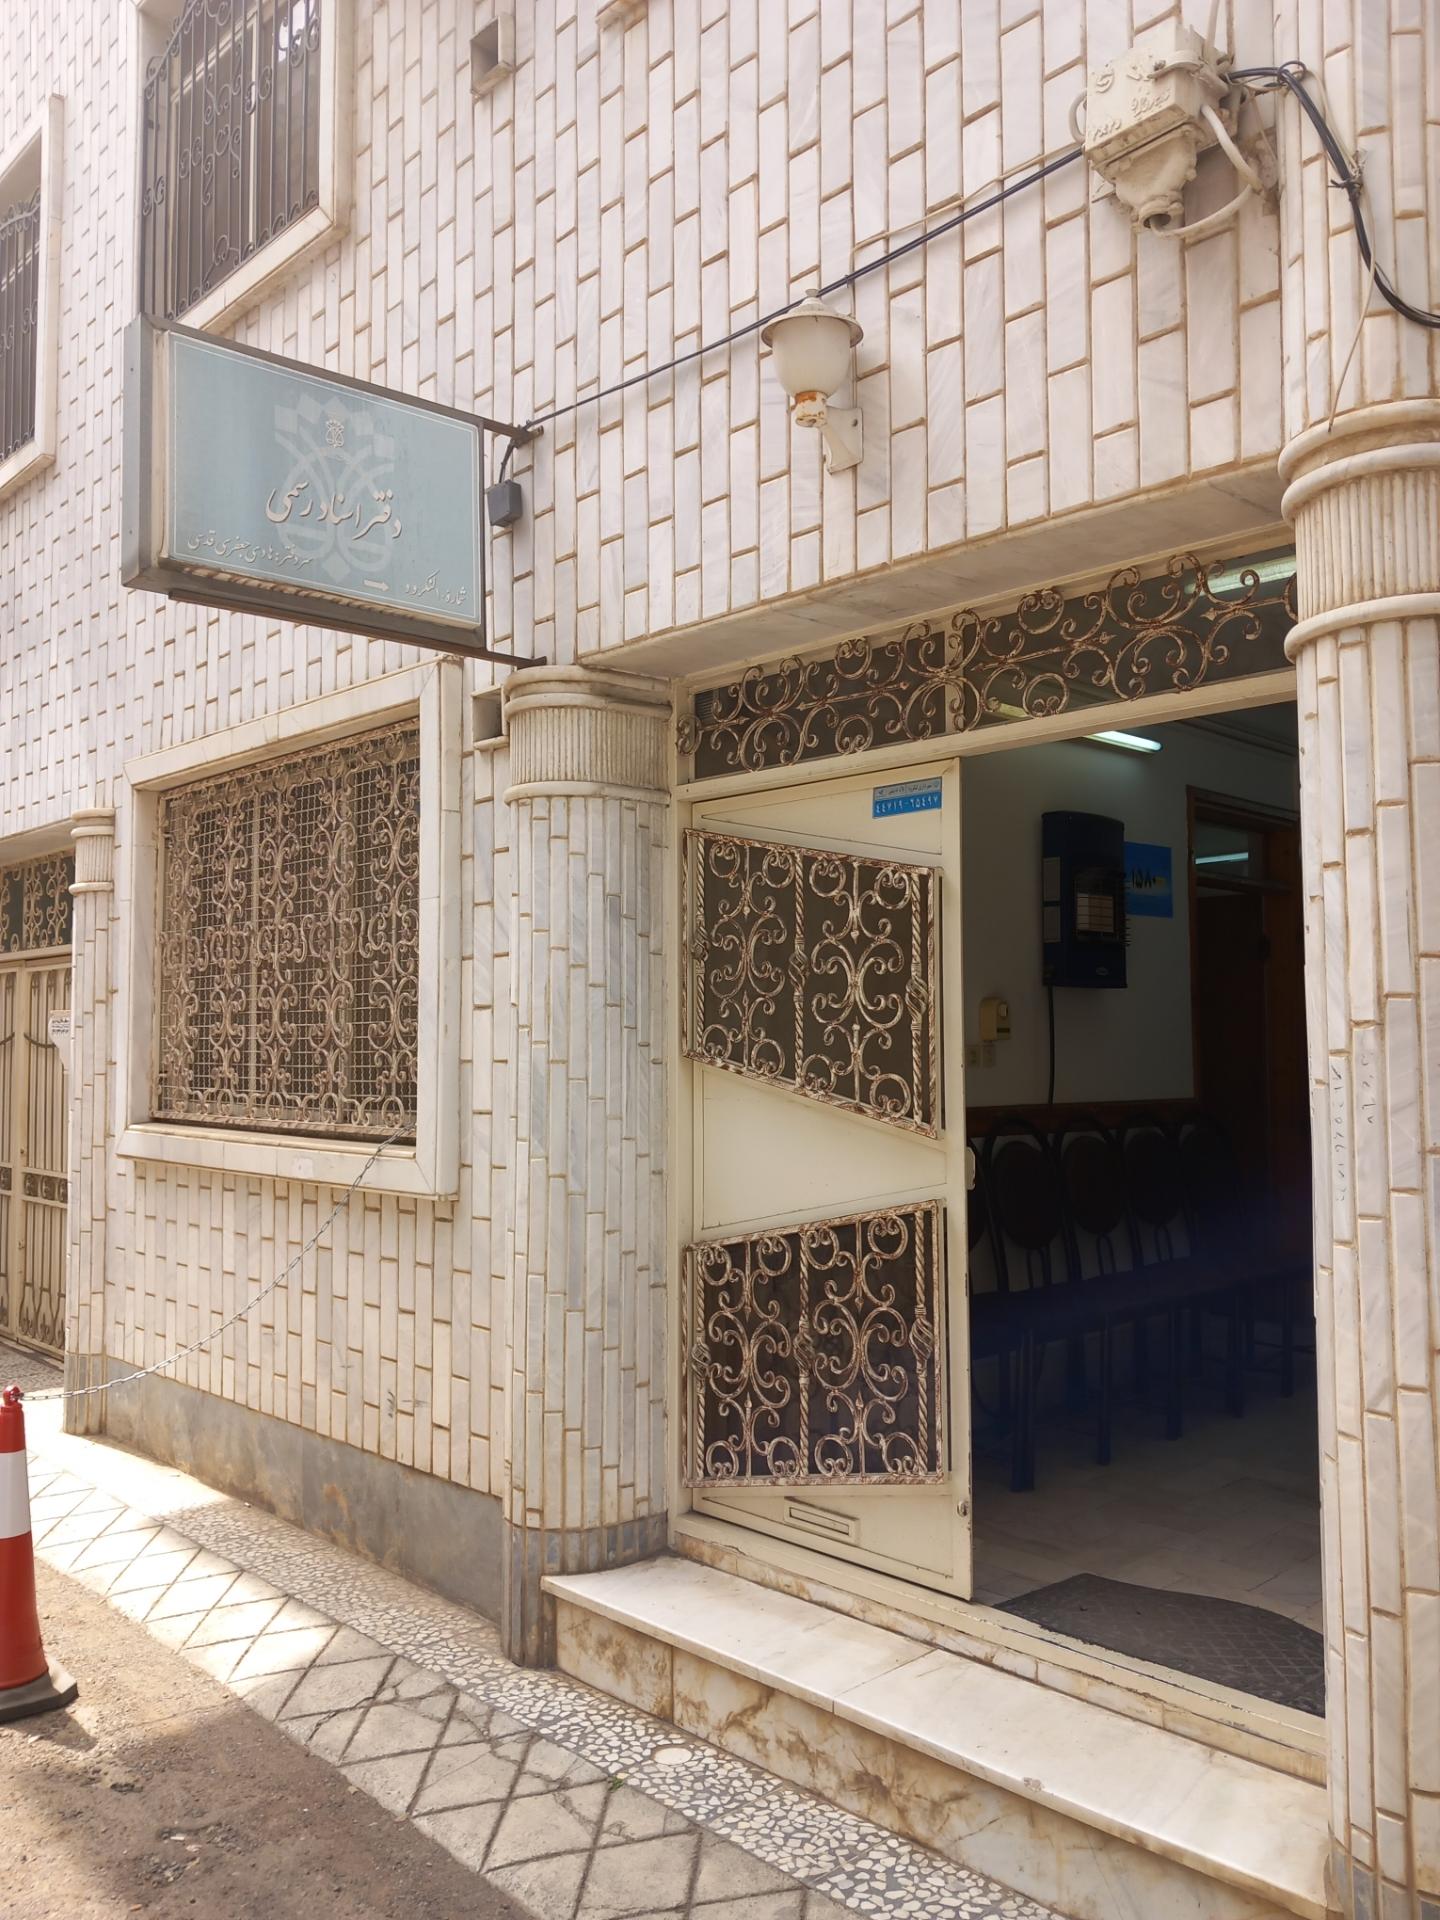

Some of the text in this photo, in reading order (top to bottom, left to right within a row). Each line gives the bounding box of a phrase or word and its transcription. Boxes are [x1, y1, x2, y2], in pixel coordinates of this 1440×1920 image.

[265, 481, 402, 540] دفتر اسناد رسمی
[187, 529, 216, 550] قدسی
[215, 535, 251, 558] جعفری
[244, 544, 273, 563] هادی
[405, 569, 441, 597] لنگرود
